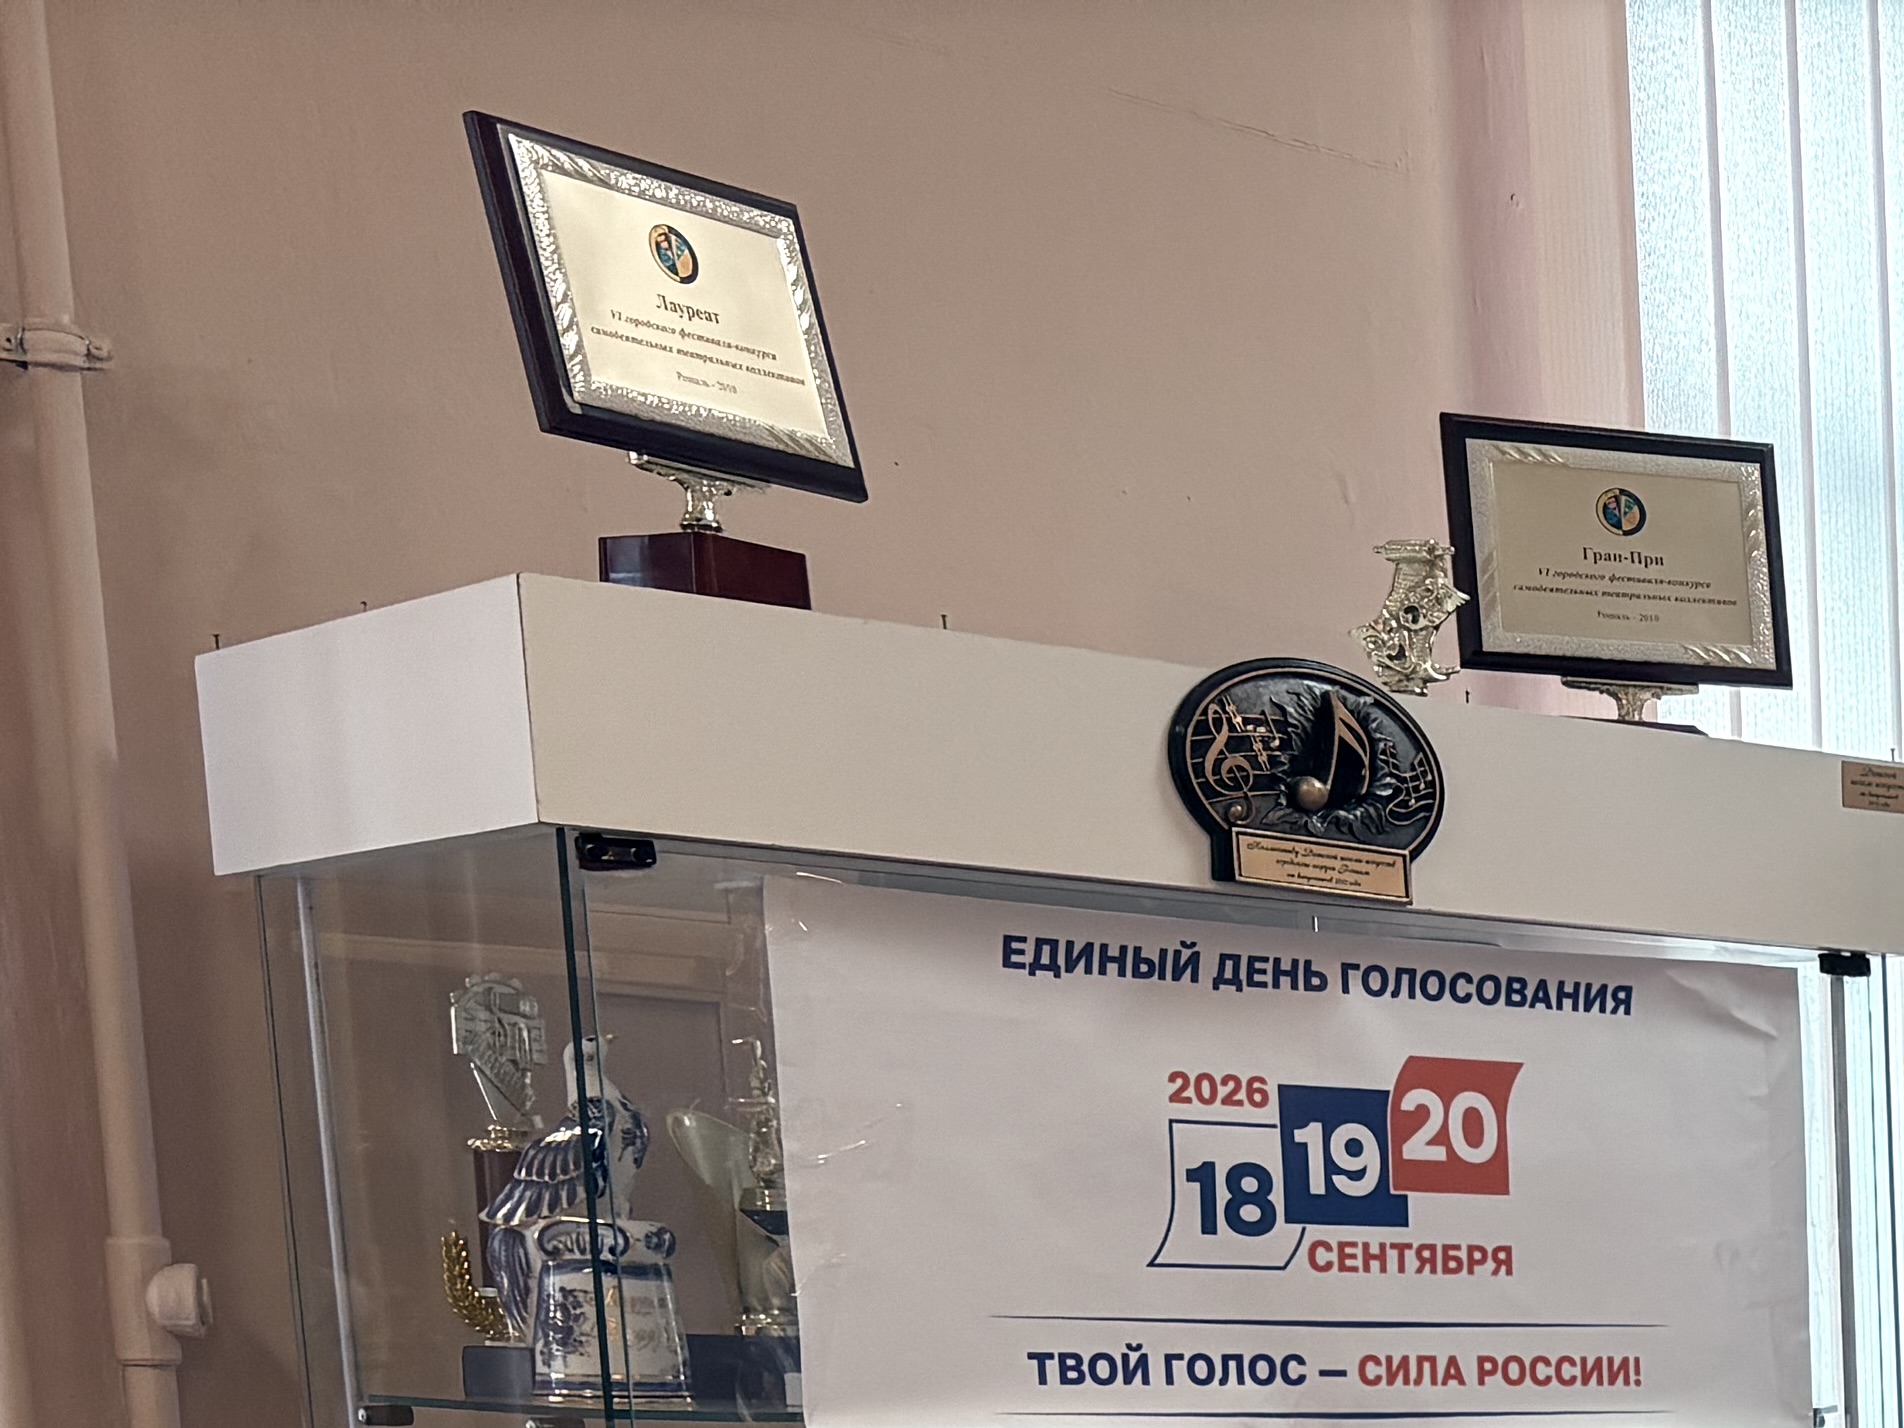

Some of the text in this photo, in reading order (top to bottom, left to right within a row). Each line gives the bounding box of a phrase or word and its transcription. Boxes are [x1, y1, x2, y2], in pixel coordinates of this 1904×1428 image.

[656, 293, 721, 325] Лауреат
[1538, 567, 1551, 577] VI
[1582, 546, 1665, 570] Гран-При
[1000, 932, 1636, 1017] ЕДИНЫЙ ДЕНЬ ГОЛОСОВАНИЯ
[1166, 1070, 1270, 1110] 2026
[1400, 1087, 1500, 1164] 20
[1292, 1120, 1383, 1197] 19
[1183, 1159, 1279, 1237] 18
[1306, 1239, 1514, 1278] СЕНТЯБРЯ
[1028, 1342, 1153, 1387] ТВОЙ
[1164, 1350, 1308, 1388] ГОЛОС
[1356, 1353, 1469, 1389] СИЛА
[1478, 1353, 1642, 1390] РОССИИ!
